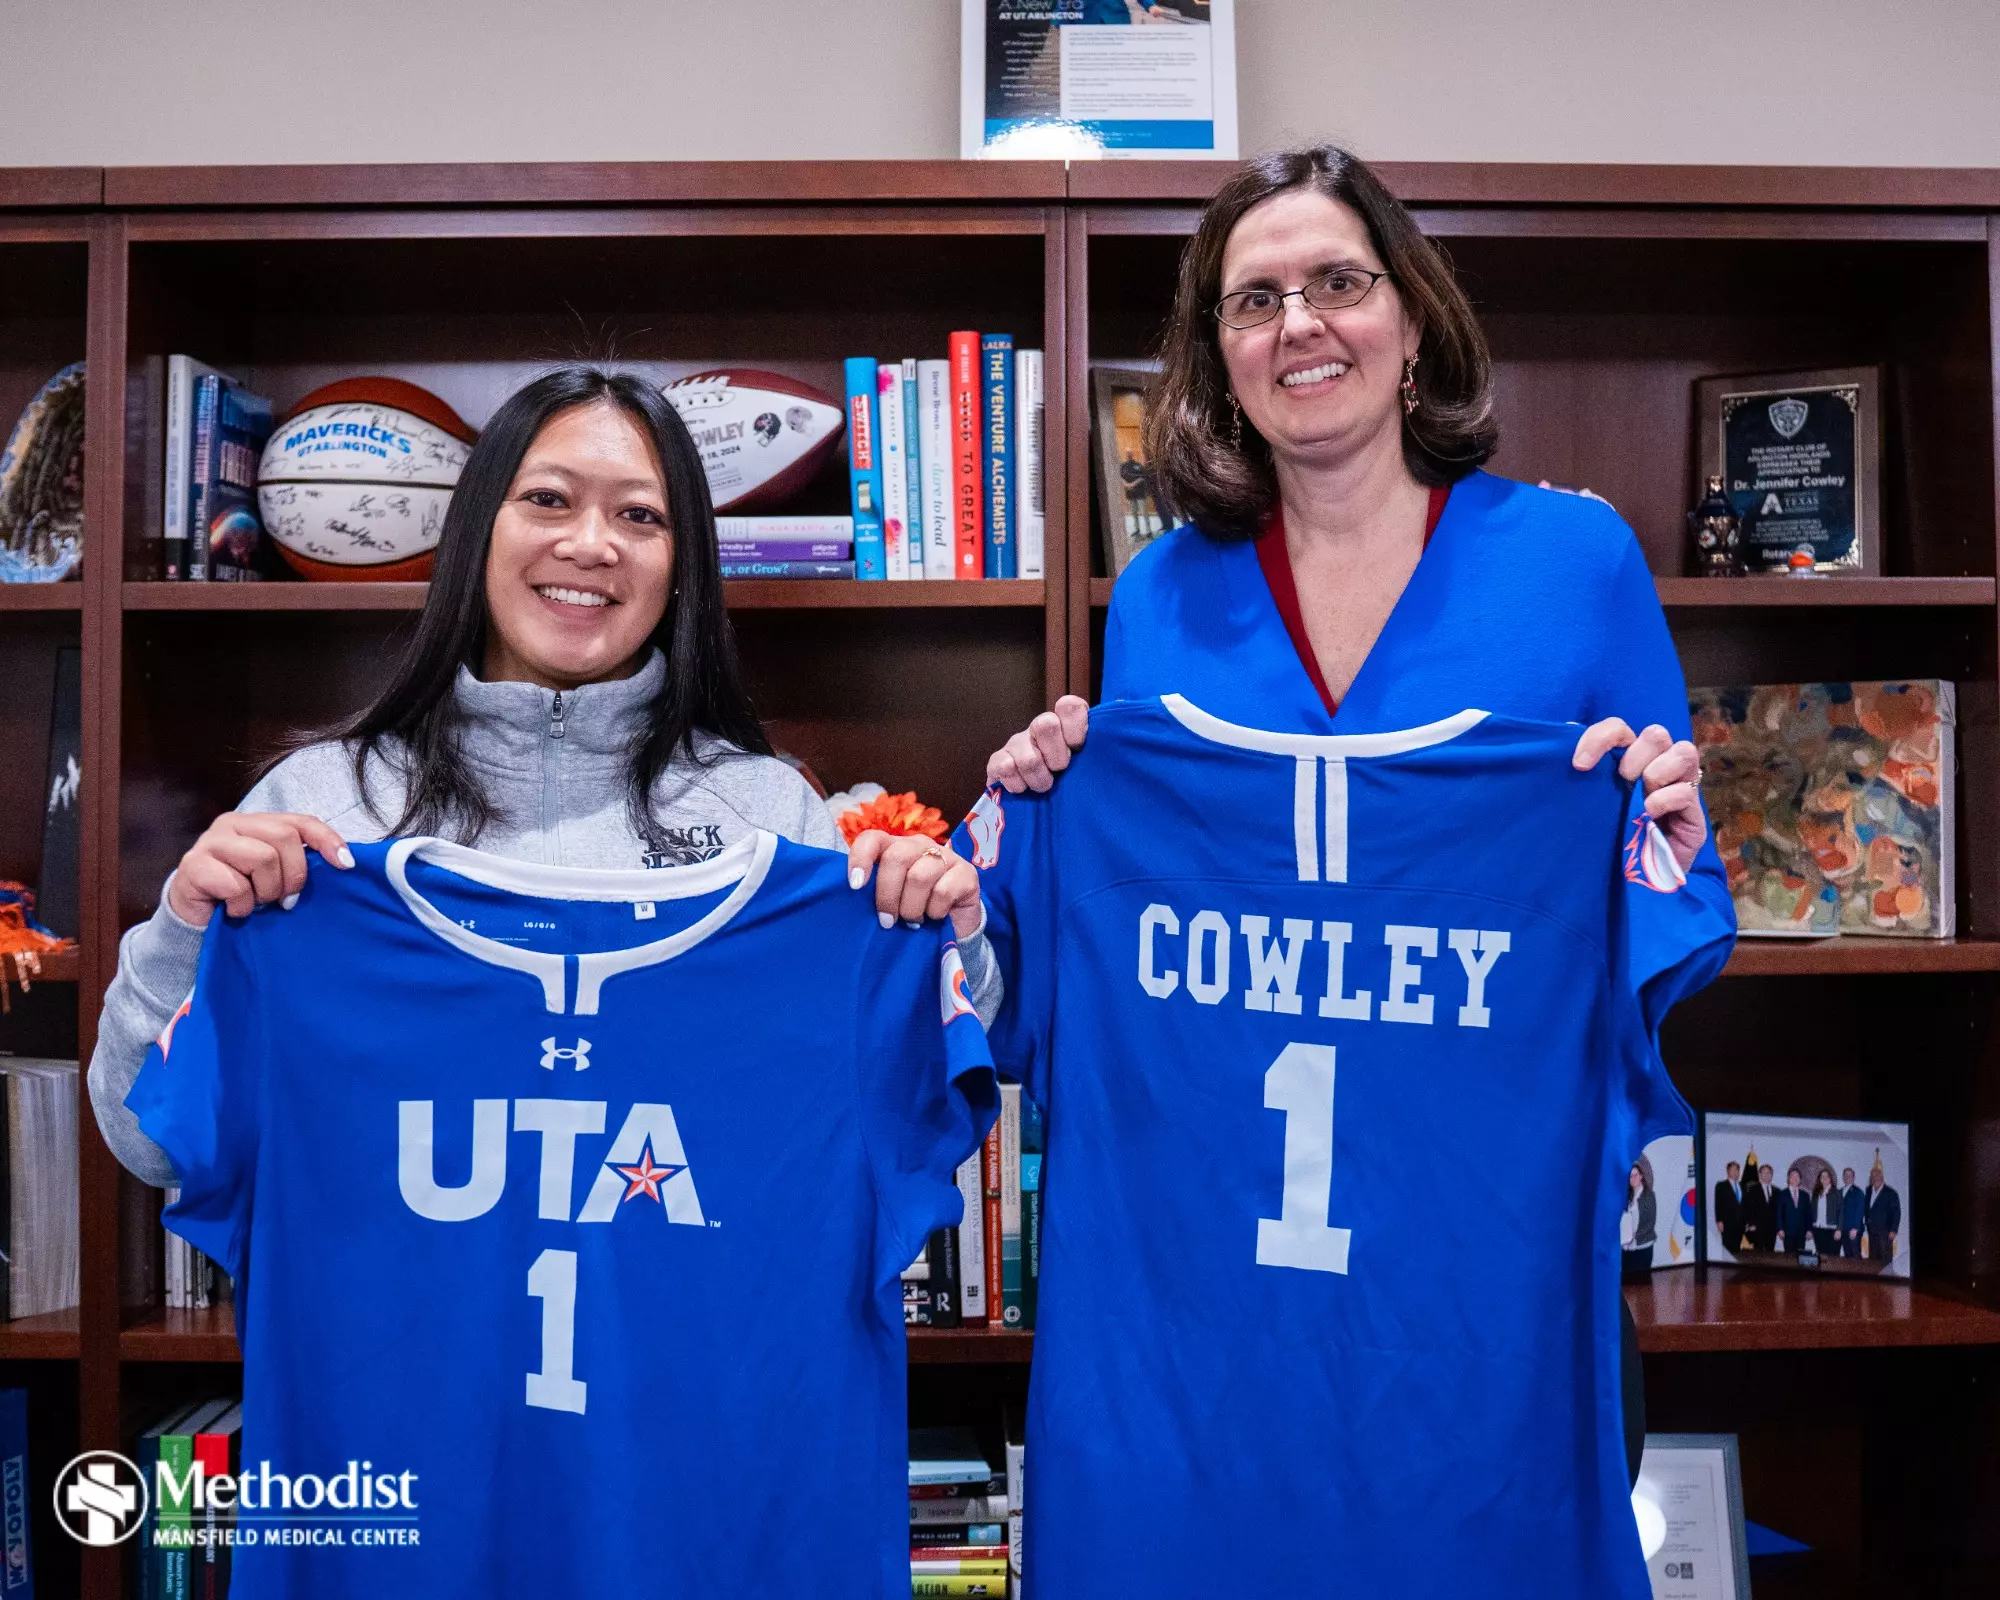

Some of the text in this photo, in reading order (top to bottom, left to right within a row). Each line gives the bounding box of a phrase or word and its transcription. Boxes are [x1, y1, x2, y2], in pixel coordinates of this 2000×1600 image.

[999, 12, 1084, 20] AT UT ARLINGTON
[854, 402, 869, 460] SWITCH
[933, 399, 941, 430] Brown
[284, 423, 411, 454] MAVERICKS
[297, 441, 388, 459] UT ARLINGTON
[692, 420, 745, 448] OWLEY
[991, 352, 1006, 545] THE VENTURE ALCHEMISTS
[961, 452, 973, 475] TO
[1734, 474, 1846, 490] Dr. Jennifer Cowley
[932, 463, 947, 547] dare to lead
[961, 484, 974, 546] GREAT
[738, 565, 749, 574] or
[752, 563, 790, 574] Grow?
[640, 903, 649, 913] W
[1138, 903, 1511, 1028] COWLEY
[398, 1099, 706, 1227] UTA
[1256, 1042, 1351, 1275] 1
[525, 1249, 587, 1415] 1
[166, 1552, 174, 1593] Biomechanics
